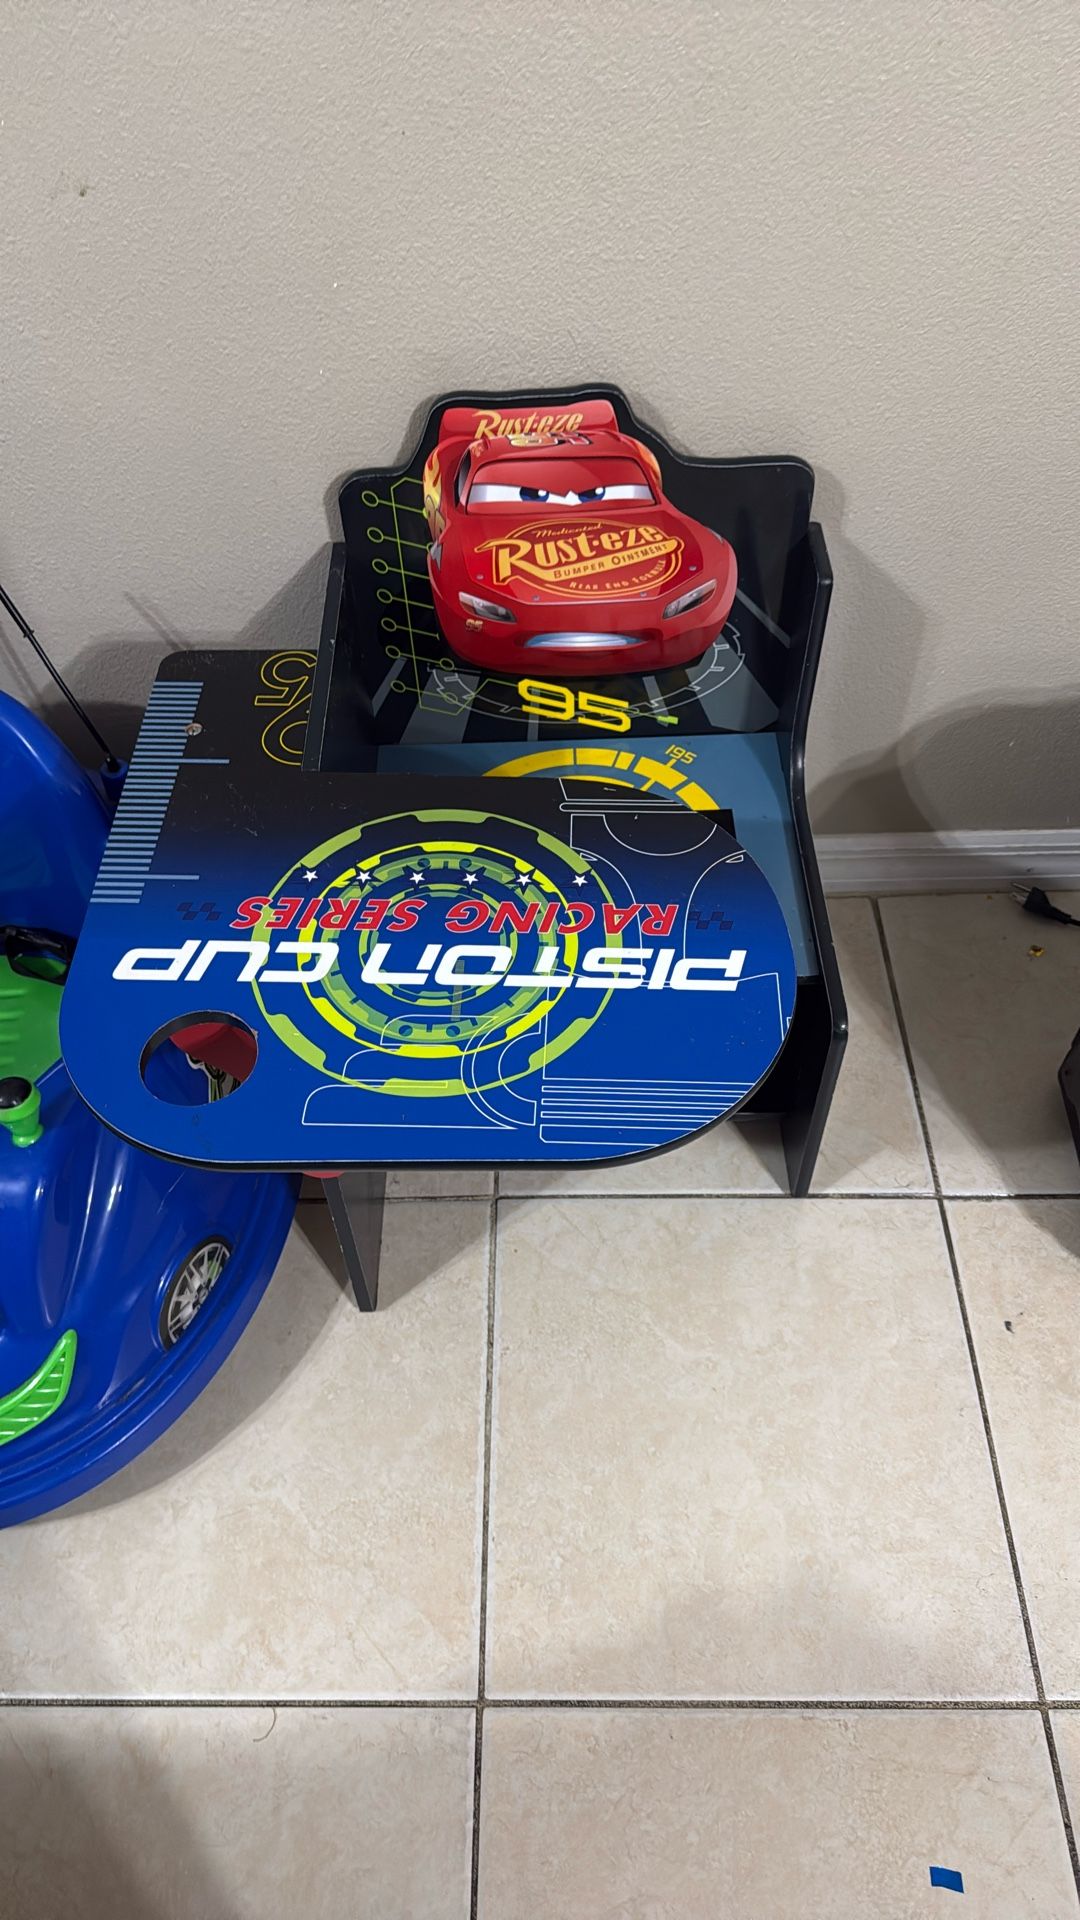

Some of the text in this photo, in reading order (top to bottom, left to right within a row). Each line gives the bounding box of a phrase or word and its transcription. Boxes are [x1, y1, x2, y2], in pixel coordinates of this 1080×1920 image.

[554, 543, 668, 579] BUMPER OINTMENT
[517, 678, 631, 732] 95
[665, 744, 697, 764] 195
[229, 896, 679, 936] RACING SERIES
[112, 939, 747, 991] PISTON CUP
